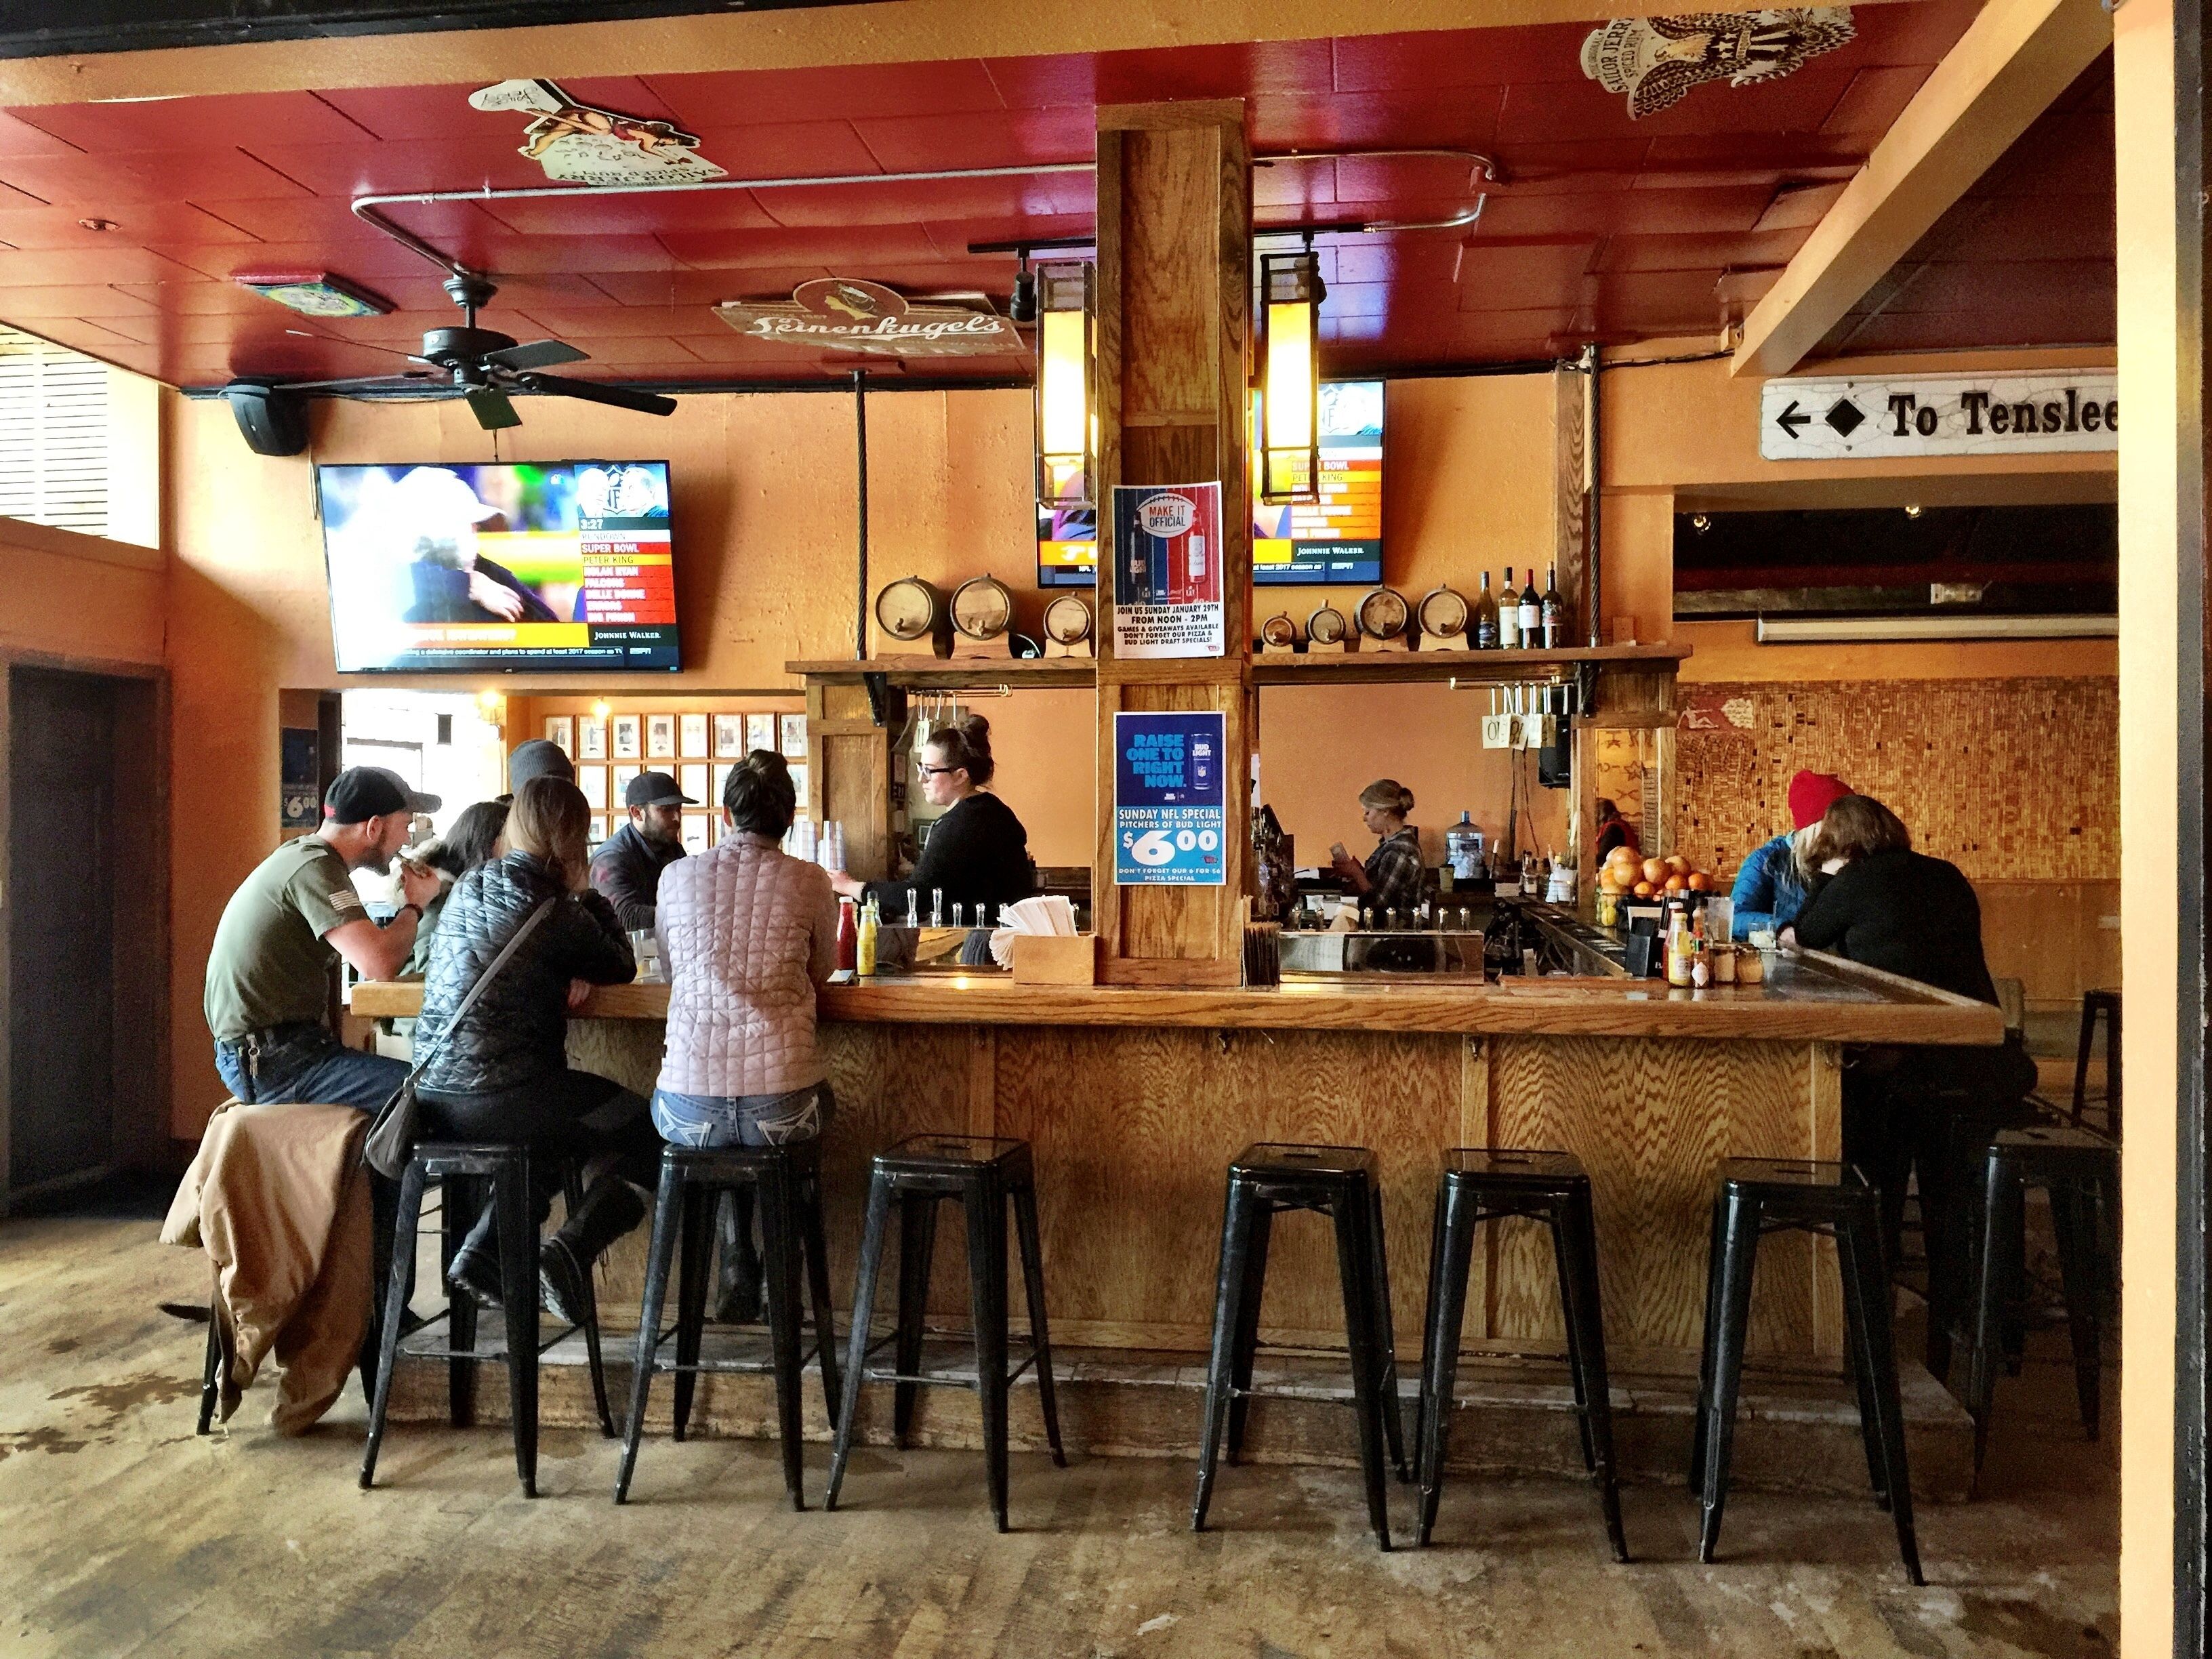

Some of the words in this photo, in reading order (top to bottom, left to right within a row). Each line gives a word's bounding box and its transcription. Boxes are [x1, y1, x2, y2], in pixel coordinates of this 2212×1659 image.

[1623, 28, 1645, 49] RUM
[1621, 50, 1639, 79] SPICED
[1601, 56, 1629, 91] SAILOR
[556, 174, 636, 182] JERRY
[641, 168, 724, 182] SAILOR
[1888, 394, 1938, 436] To
[1292, 462, 1322, 471] SUP
[1324, 462, 1350, 471] BOWL
[1322, 474, 1343, 482] KING
[1149, 506, 1173, 516] MAKE
[1178, 505, 1185, 516] IT
[580, 519, 604, 530] 3:27
[1149, 516, 1185, 527] OFFICIAL
[582, 544, 612, 553] SUPER
[614, 543, 639, 553] BOWL
[1297, 547, 1330, 556] JOHNNIE
[613, 556, 634, 564] KING
[1118, 607, 1132, 615] JOIN
[1134, 607, 1143, 615] US
[1145, 606, 1170, 615] SUNDAY
[1172, 605, 1202, 614] JANUARY
[1203, 604, 1218, 612] 29TH
[1131, 616, 1155, 624] FROM
[1157, 615, 1182, 623] NOON
[1191, 614, 1208, 622] 2PM
[594, 632, 627, 640] JOHNNIE
[1134, 734, 1185, 747] RAISE
[1126, 747, 1160, 760] ONE
[1162, 747, 1185, 760] TO
[1133, 761, 1185, 774] RIGHT
[1145, 775, 1187, 787] NOW.
[1119, 808, 1158, 820] SUNDAY
[1161, 808, 1179, 819] NFL
[1182, 808, 1221, 819] SPECIAL
